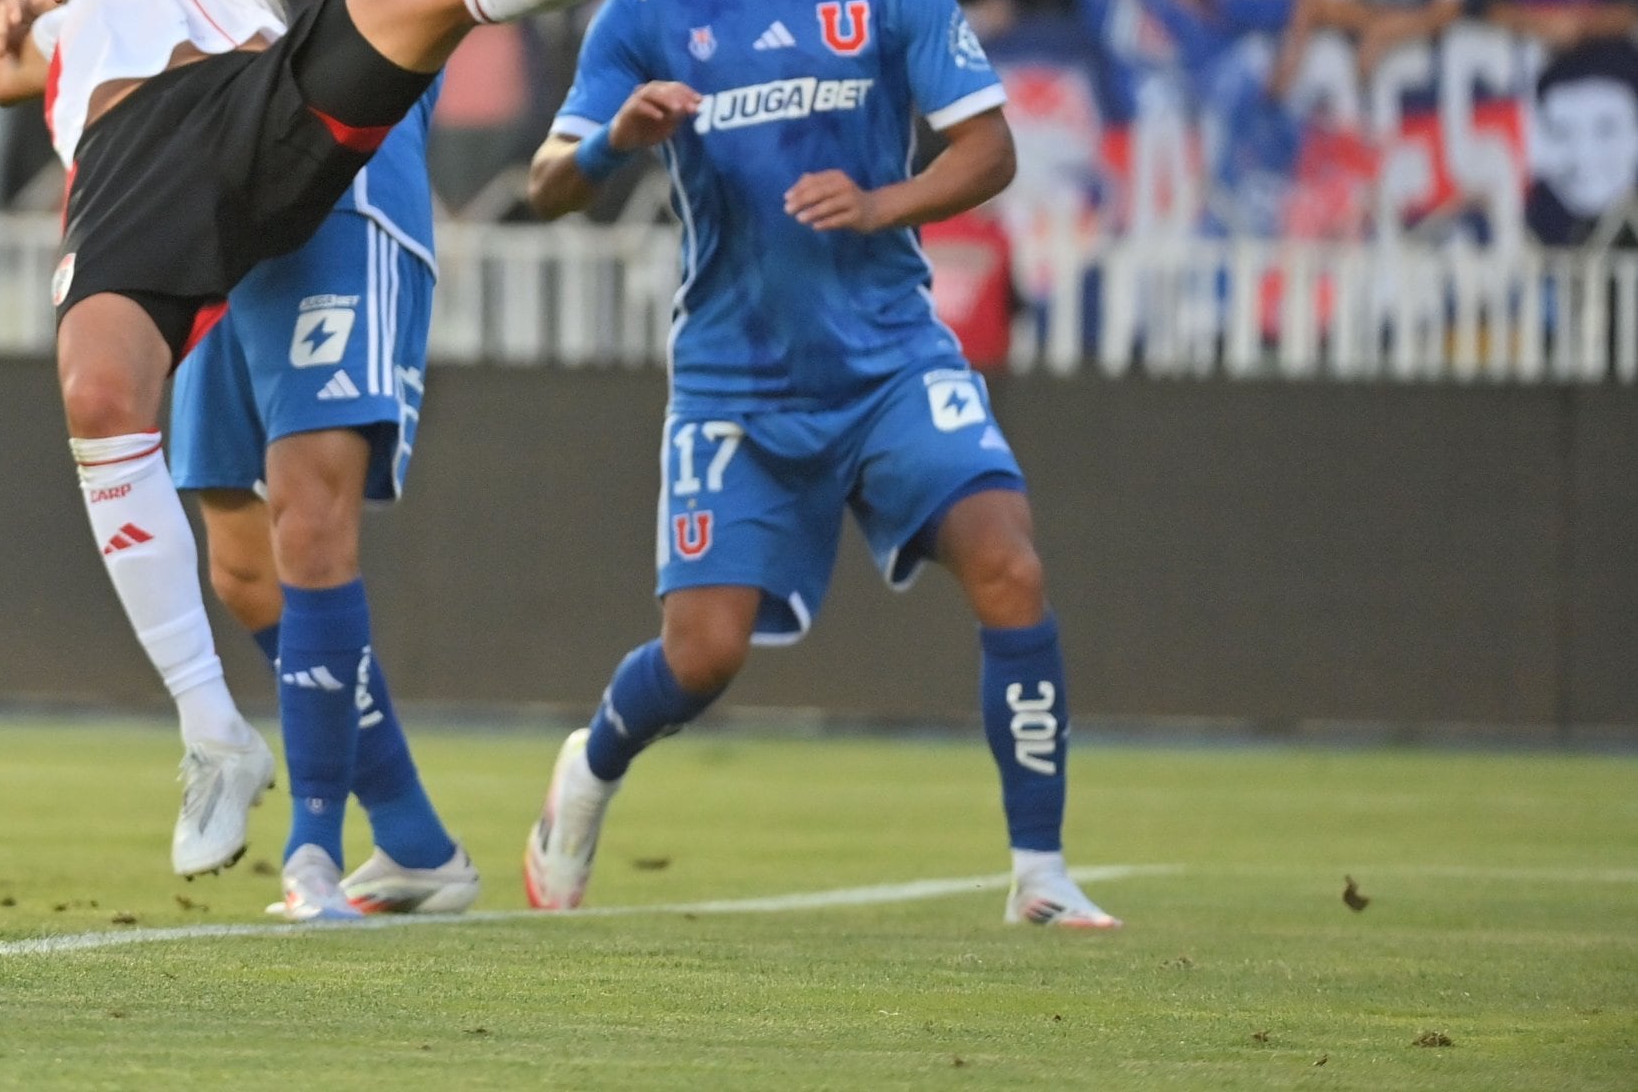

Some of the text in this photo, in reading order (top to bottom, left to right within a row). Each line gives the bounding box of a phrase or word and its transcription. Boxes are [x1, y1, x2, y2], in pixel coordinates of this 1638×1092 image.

[816, 0, 870, 57] U
[673, 420, 744, 496] 17
[672, 509, 714, 561] U
